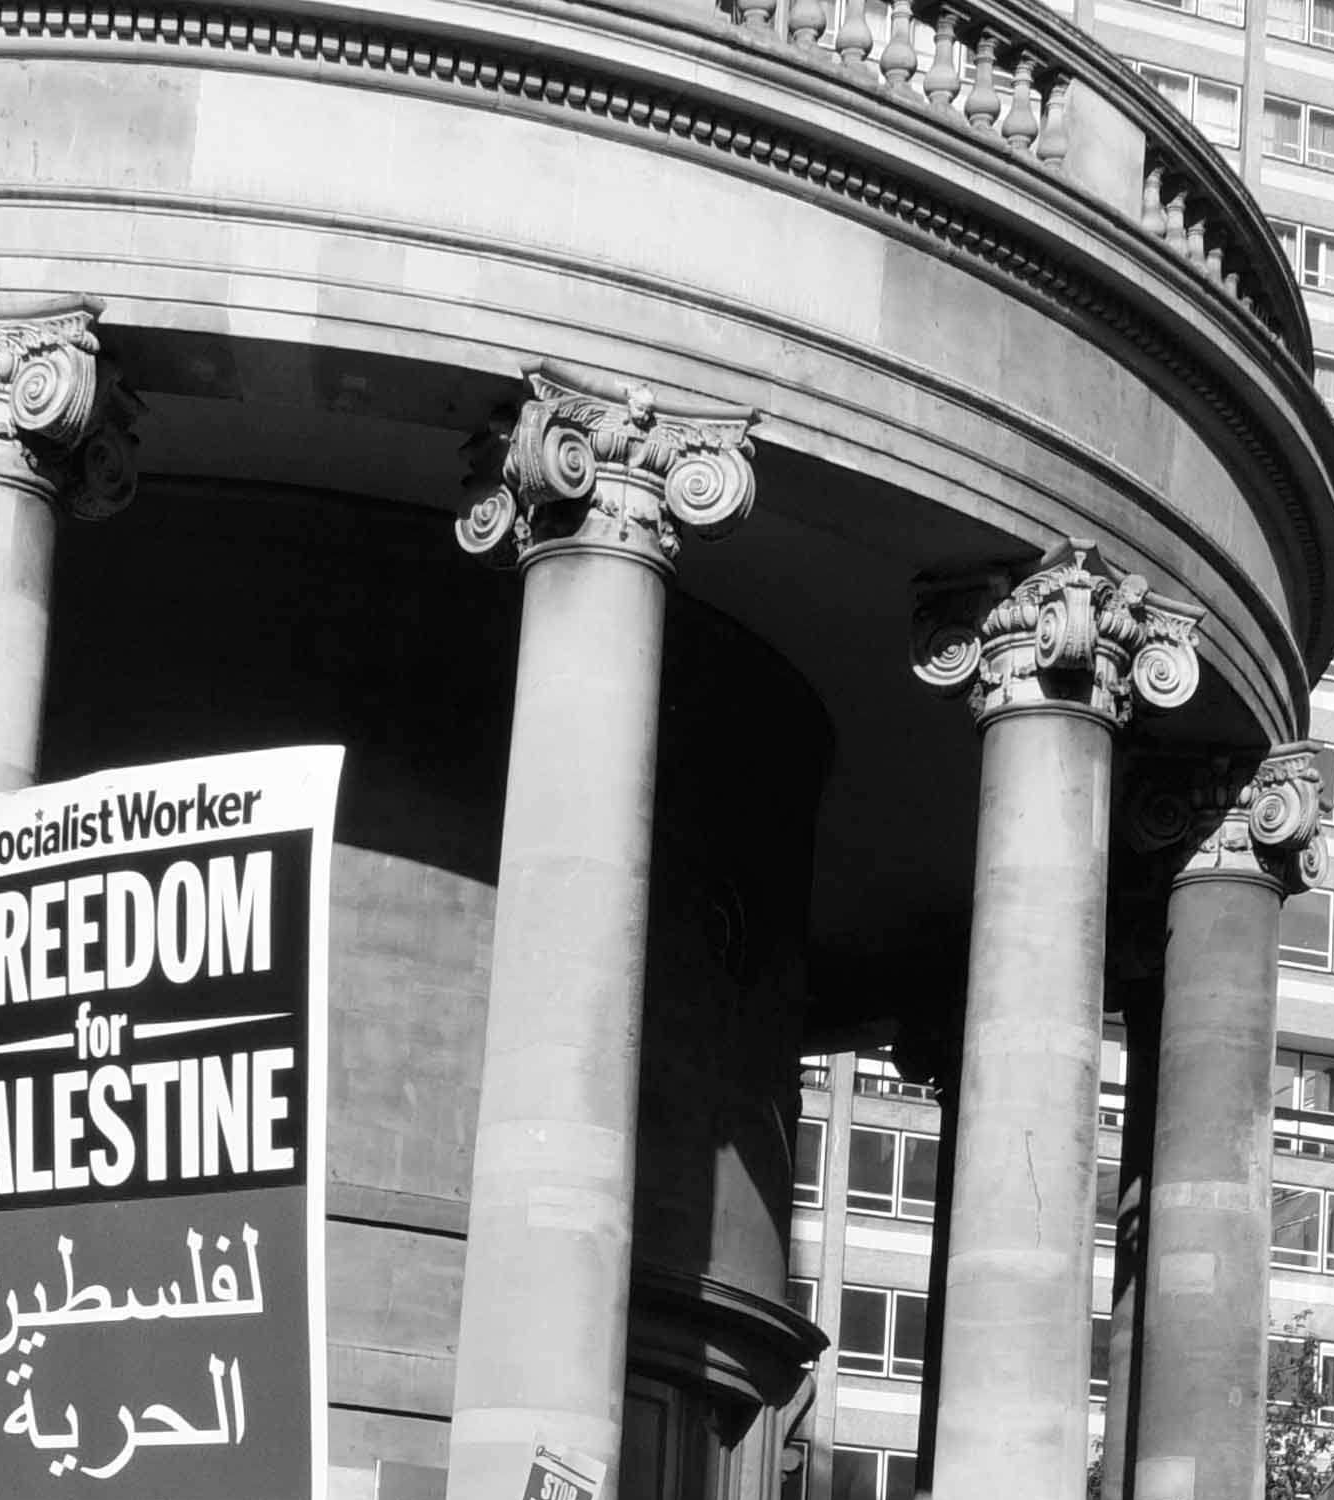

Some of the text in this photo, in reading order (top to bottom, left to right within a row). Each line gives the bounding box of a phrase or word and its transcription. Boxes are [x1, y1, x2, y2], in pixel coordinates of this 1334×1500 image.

[117, 782, 263, 841] Worker
[75, 1001, 128, 1060] for
[2, 1352, 247, 1483] الحرية
